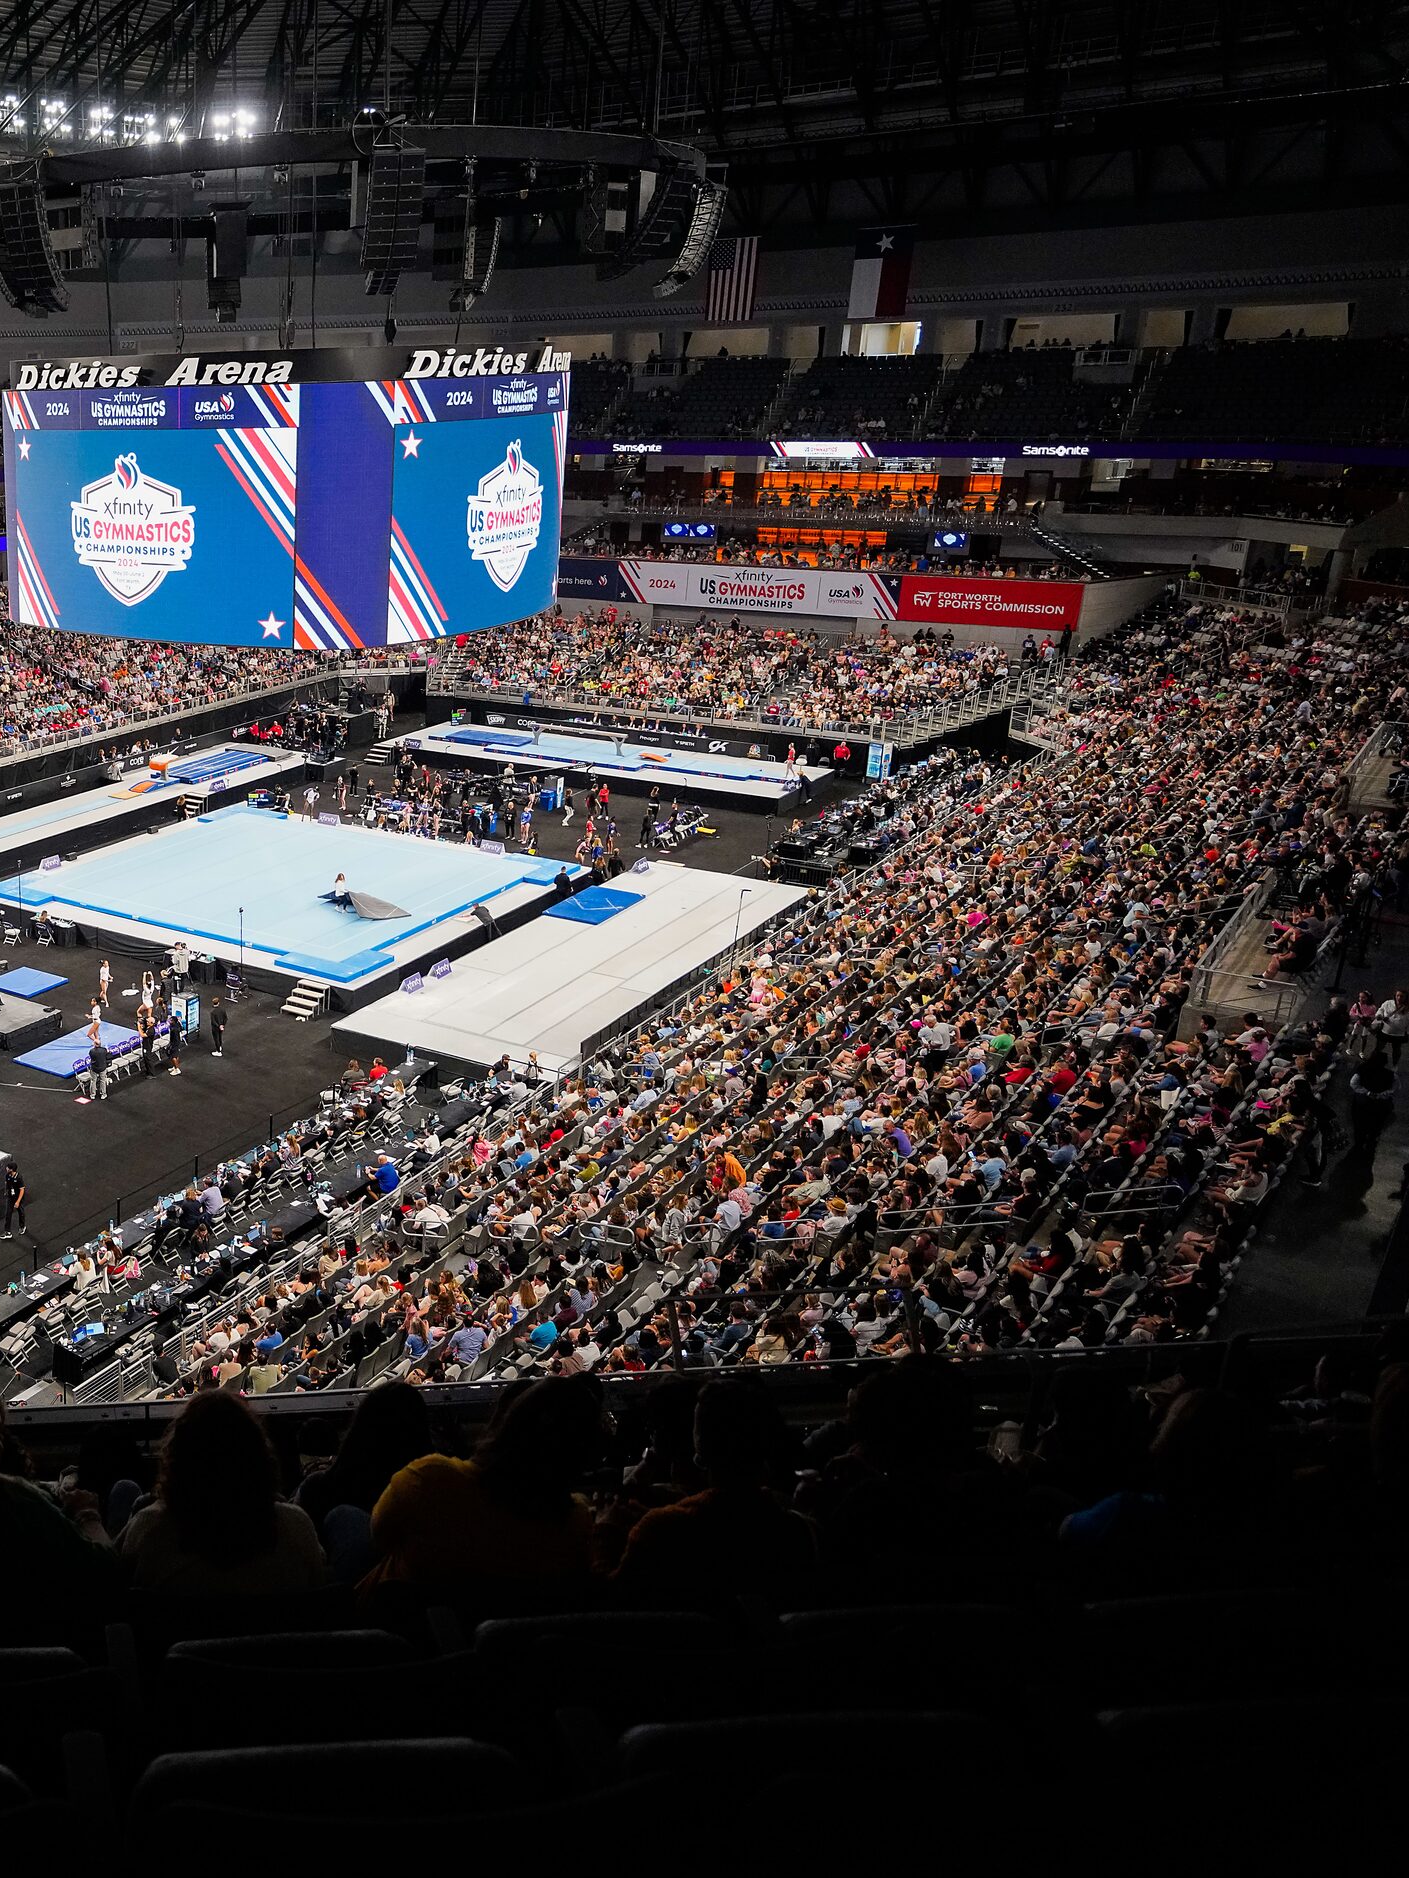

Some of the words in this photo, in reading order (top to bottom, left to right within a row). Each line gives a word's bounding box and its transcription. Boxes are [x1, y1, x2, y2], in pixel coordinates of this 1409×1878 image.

[403, 347, 528, 379] Dickies
[16, 360, 141, 390] Dickies
[165, 357, 294, 386] Arena
[509, 378, 527, 390] xfinity
[113, 391, 141, 404] xfinity
[446, 391, 473, 406] 2024
[503, 387, 538, 405] GYMNASTICS
[46, 402, 70, 416] 2024
[103, 399, 166, 417] GYMNASTICS
[194, 401, 220, 413] USA
[497, 404, 533, 414] CHAMPIONSHIPS
[97, 417, 158, 426] CHAMPIONSHIPS
[194, 413, 235, 422] Gymnastics
[612, 443, 662, 454] Samsonite
[1022, 444, 1089, 457] Samsonite
[496, 484, 526, 507] xfinity
[104, 497, 153, 520] xfinity
[471, 509, 484, 532] U.S.
[486, 499, 540, 530] GYMNASTICS
[75, 515, 91, 539] U.S.
[93, 519, 191, 543] GYMNASTICS
[479, 527, 534, 545] CHAMPIONSHIPS
[86, 543, 175, 556] CHAMPIONSHIPS
[118, 558, 139, 567] 2024
[574, 577, 594, 586] here.
[734, 569, 773, 583] xfinity
[649, 578, 676, 589] 2024
[699, 577, 717, 596] U.S.
[718, 578, 805, 601] GYMNASTICS
[828, 588, 850, 599] USA
[938, 591, 963, 600] FORT
[965, 593, 1001, 602] WORTH
[708, 596, 793, 609] CHAMPIONSHIPS
[828, 597, 863, 606] Gymnastics
[937, 599, 982, 610] SPORTS
[984, 602, 1065, 615] COMMISSION
[129, 756, 145, 766] core
[319, 813, 337, 823] xfinity
[44, 857, 60, 868] xfinity
